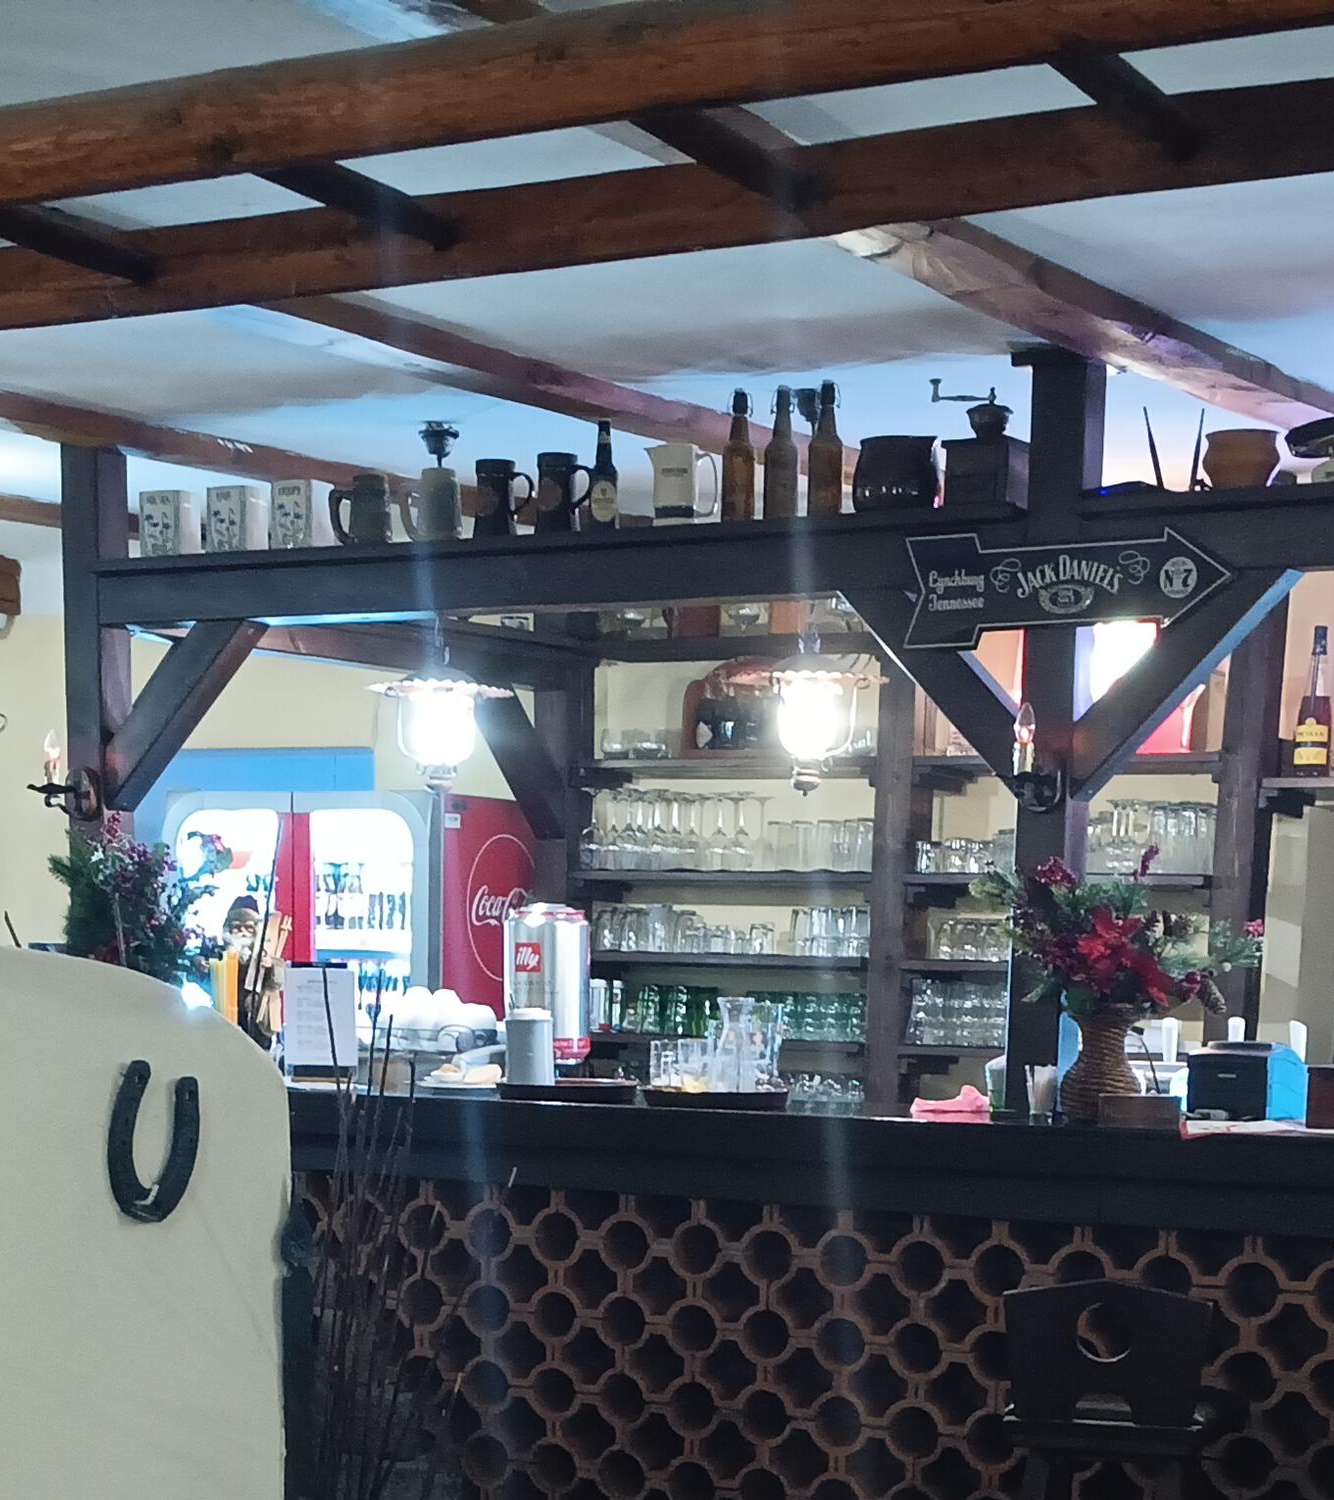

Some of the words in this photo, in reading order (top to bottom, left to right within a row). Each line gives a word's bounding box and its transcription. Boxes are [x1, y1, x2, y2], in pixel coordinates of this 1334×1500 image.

[928, 569, 985, 594] Lynchburg
[1016, 564, 1057, 599] JACK
[928, 594, 985, 611] Tennessee
[516, 946, 540, 970] illy
